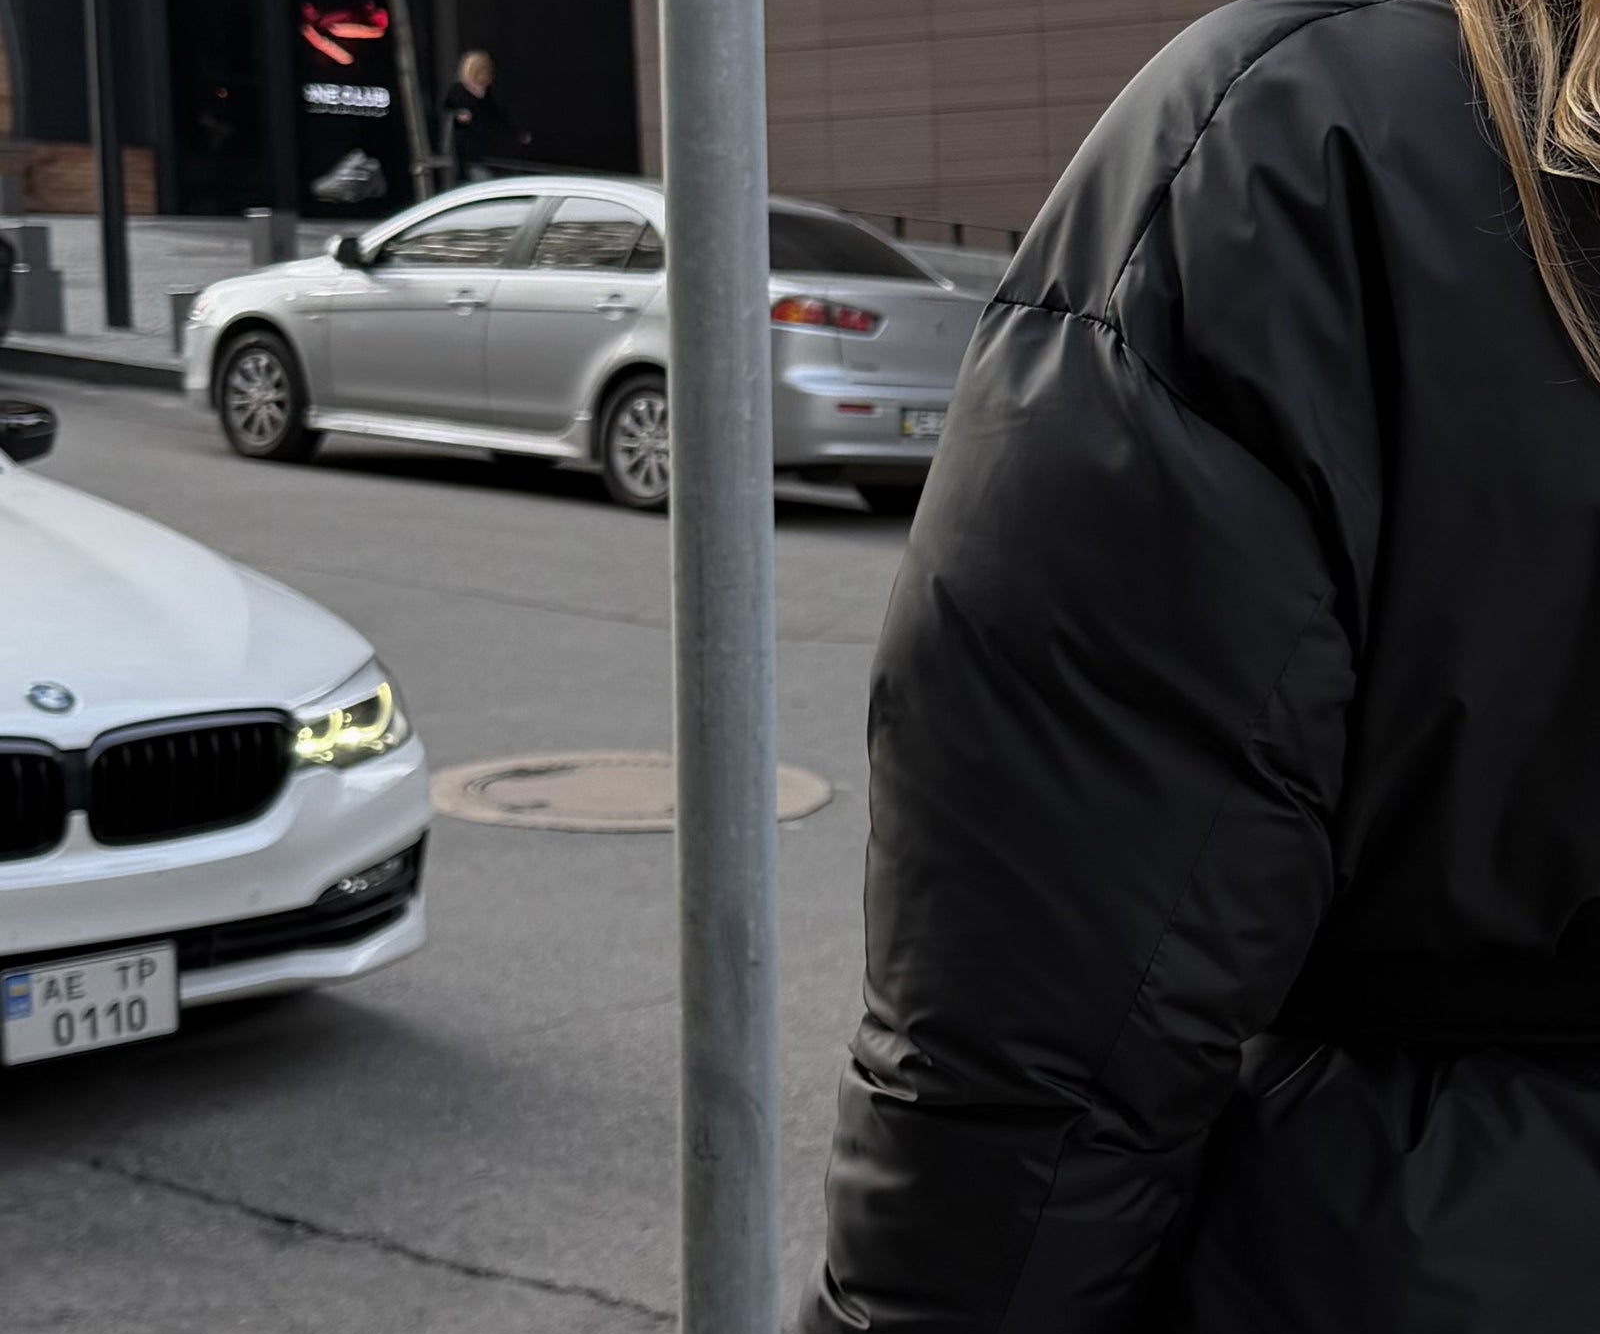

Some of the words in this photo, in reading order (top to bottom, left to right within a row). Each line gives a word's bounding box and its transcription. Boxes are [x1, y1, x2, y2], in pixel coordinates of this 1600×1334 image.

[43, 970, 87, 1005] AE
[115, 956, 157, 991] TP
[53, 995, 147, 1046] 0110
